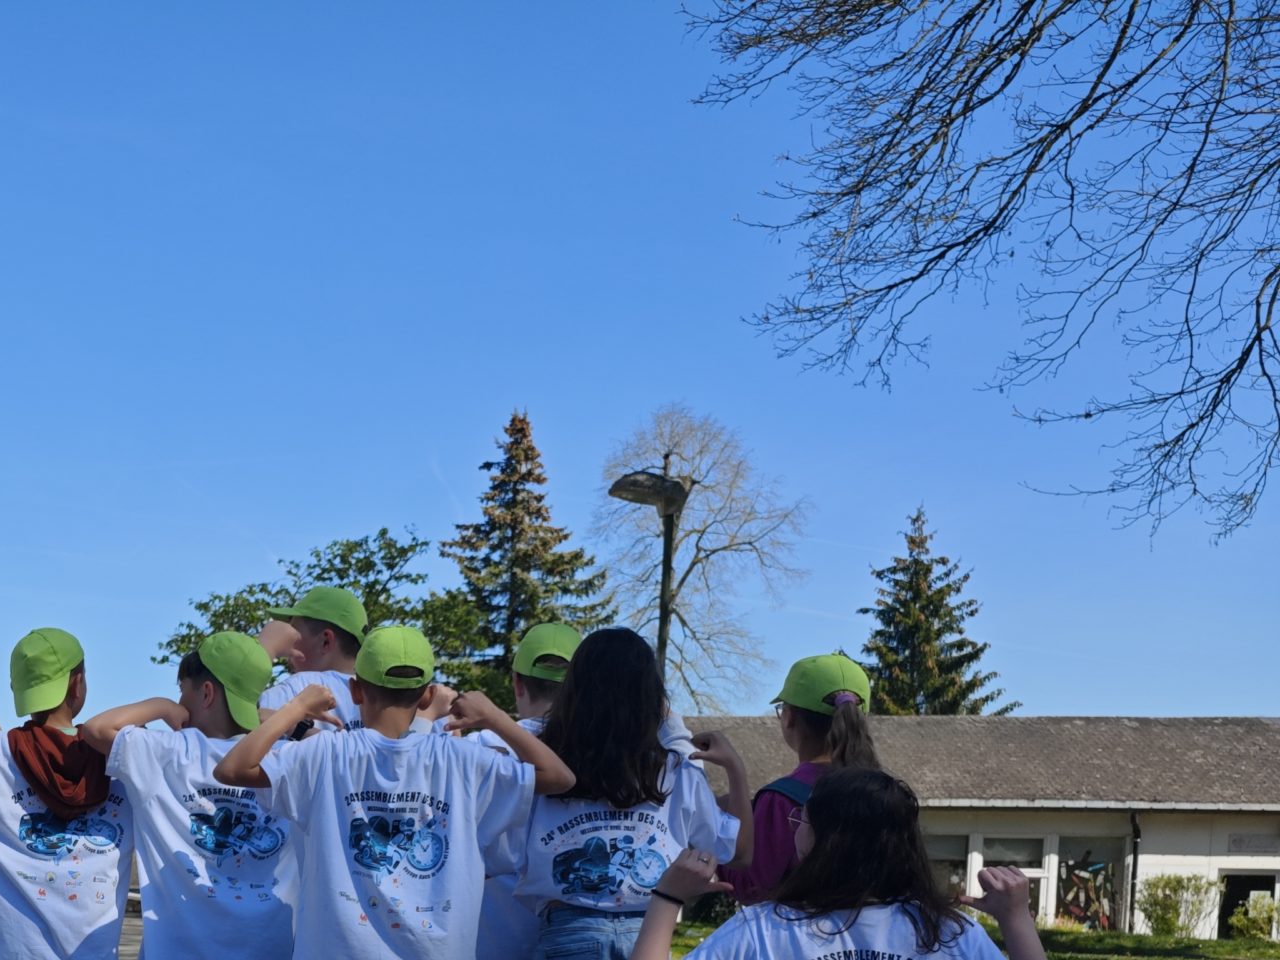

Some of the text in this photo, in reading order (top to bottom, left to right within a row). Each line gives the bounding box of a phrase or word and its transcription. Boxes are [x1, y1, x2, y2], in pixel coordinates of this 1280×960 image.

[355, 790, 421, 803] SSEMBLEMENT
[540, 830, 555, 846] 24e
[557, 811, 635, 835] RASSEMBLEMENT
[637, 812, 655, 825] DES
